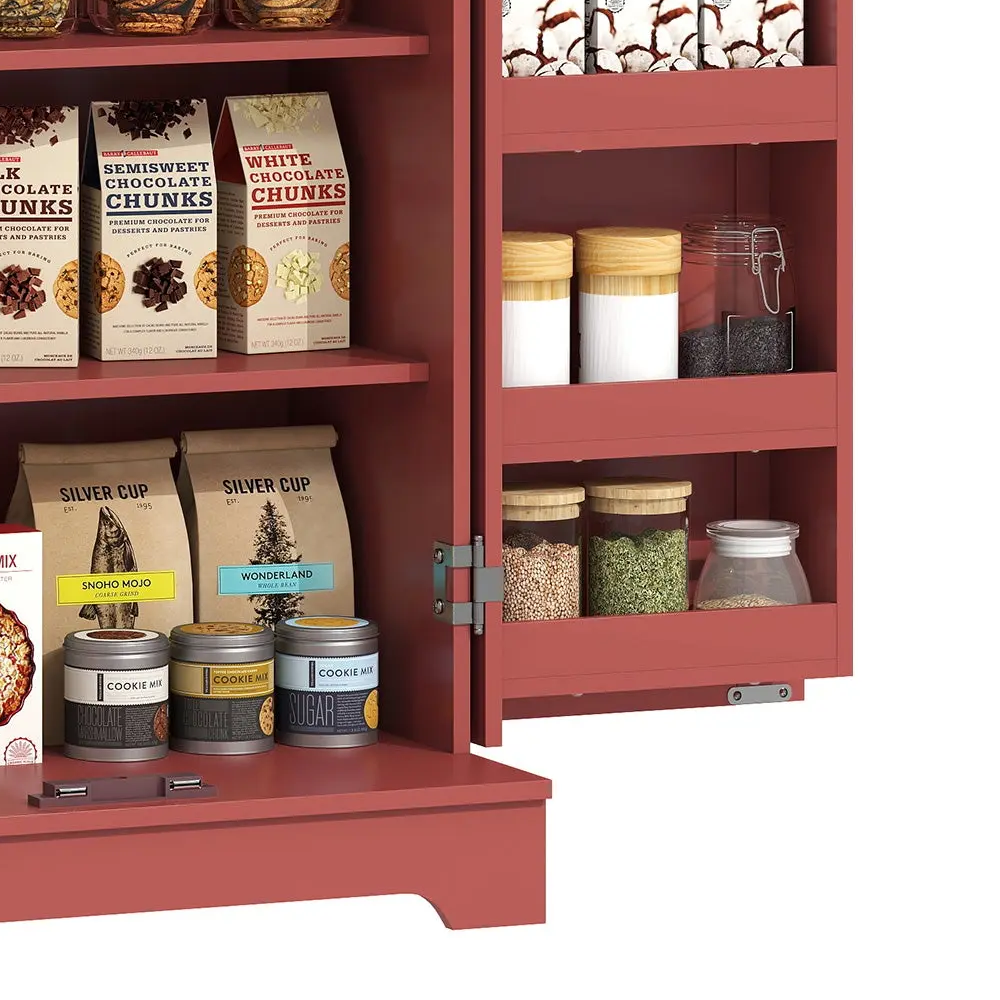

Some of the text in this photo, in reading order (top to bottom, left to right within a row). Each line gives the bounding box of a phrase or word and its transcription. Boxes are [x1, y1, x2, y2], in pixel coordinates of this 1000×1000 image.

[245, 153, 312, 169] WHITE
[103, 162, 210, 175] SEMISWEET
[250, 168, 345, 183] CHOCOLATE
[105, 176, 212, 189] CHOCOLATE
[251, 183, 346, 203] CHUNKS
[105, 191, 213, 209] CHUNKS
[254, 212, 287, 220] PREMIUM
[287, 210, 328, 218] CHOCOLATE
[222, 476, 310, 495] SILVER CUP
[60, 483, 149, 503] SILVER CUP
[241, 570, 313, 581] WONDERLAND
[82, 578, 151, 590] SNOHO MOJO
[213, 672, 269, 684] COOKIE MIX
[318, 666, 374, 678] COOKIE MIX
[107, 679, 163, 691] COOKIE MIX
[289, 692, 334, 726] SUGAR
